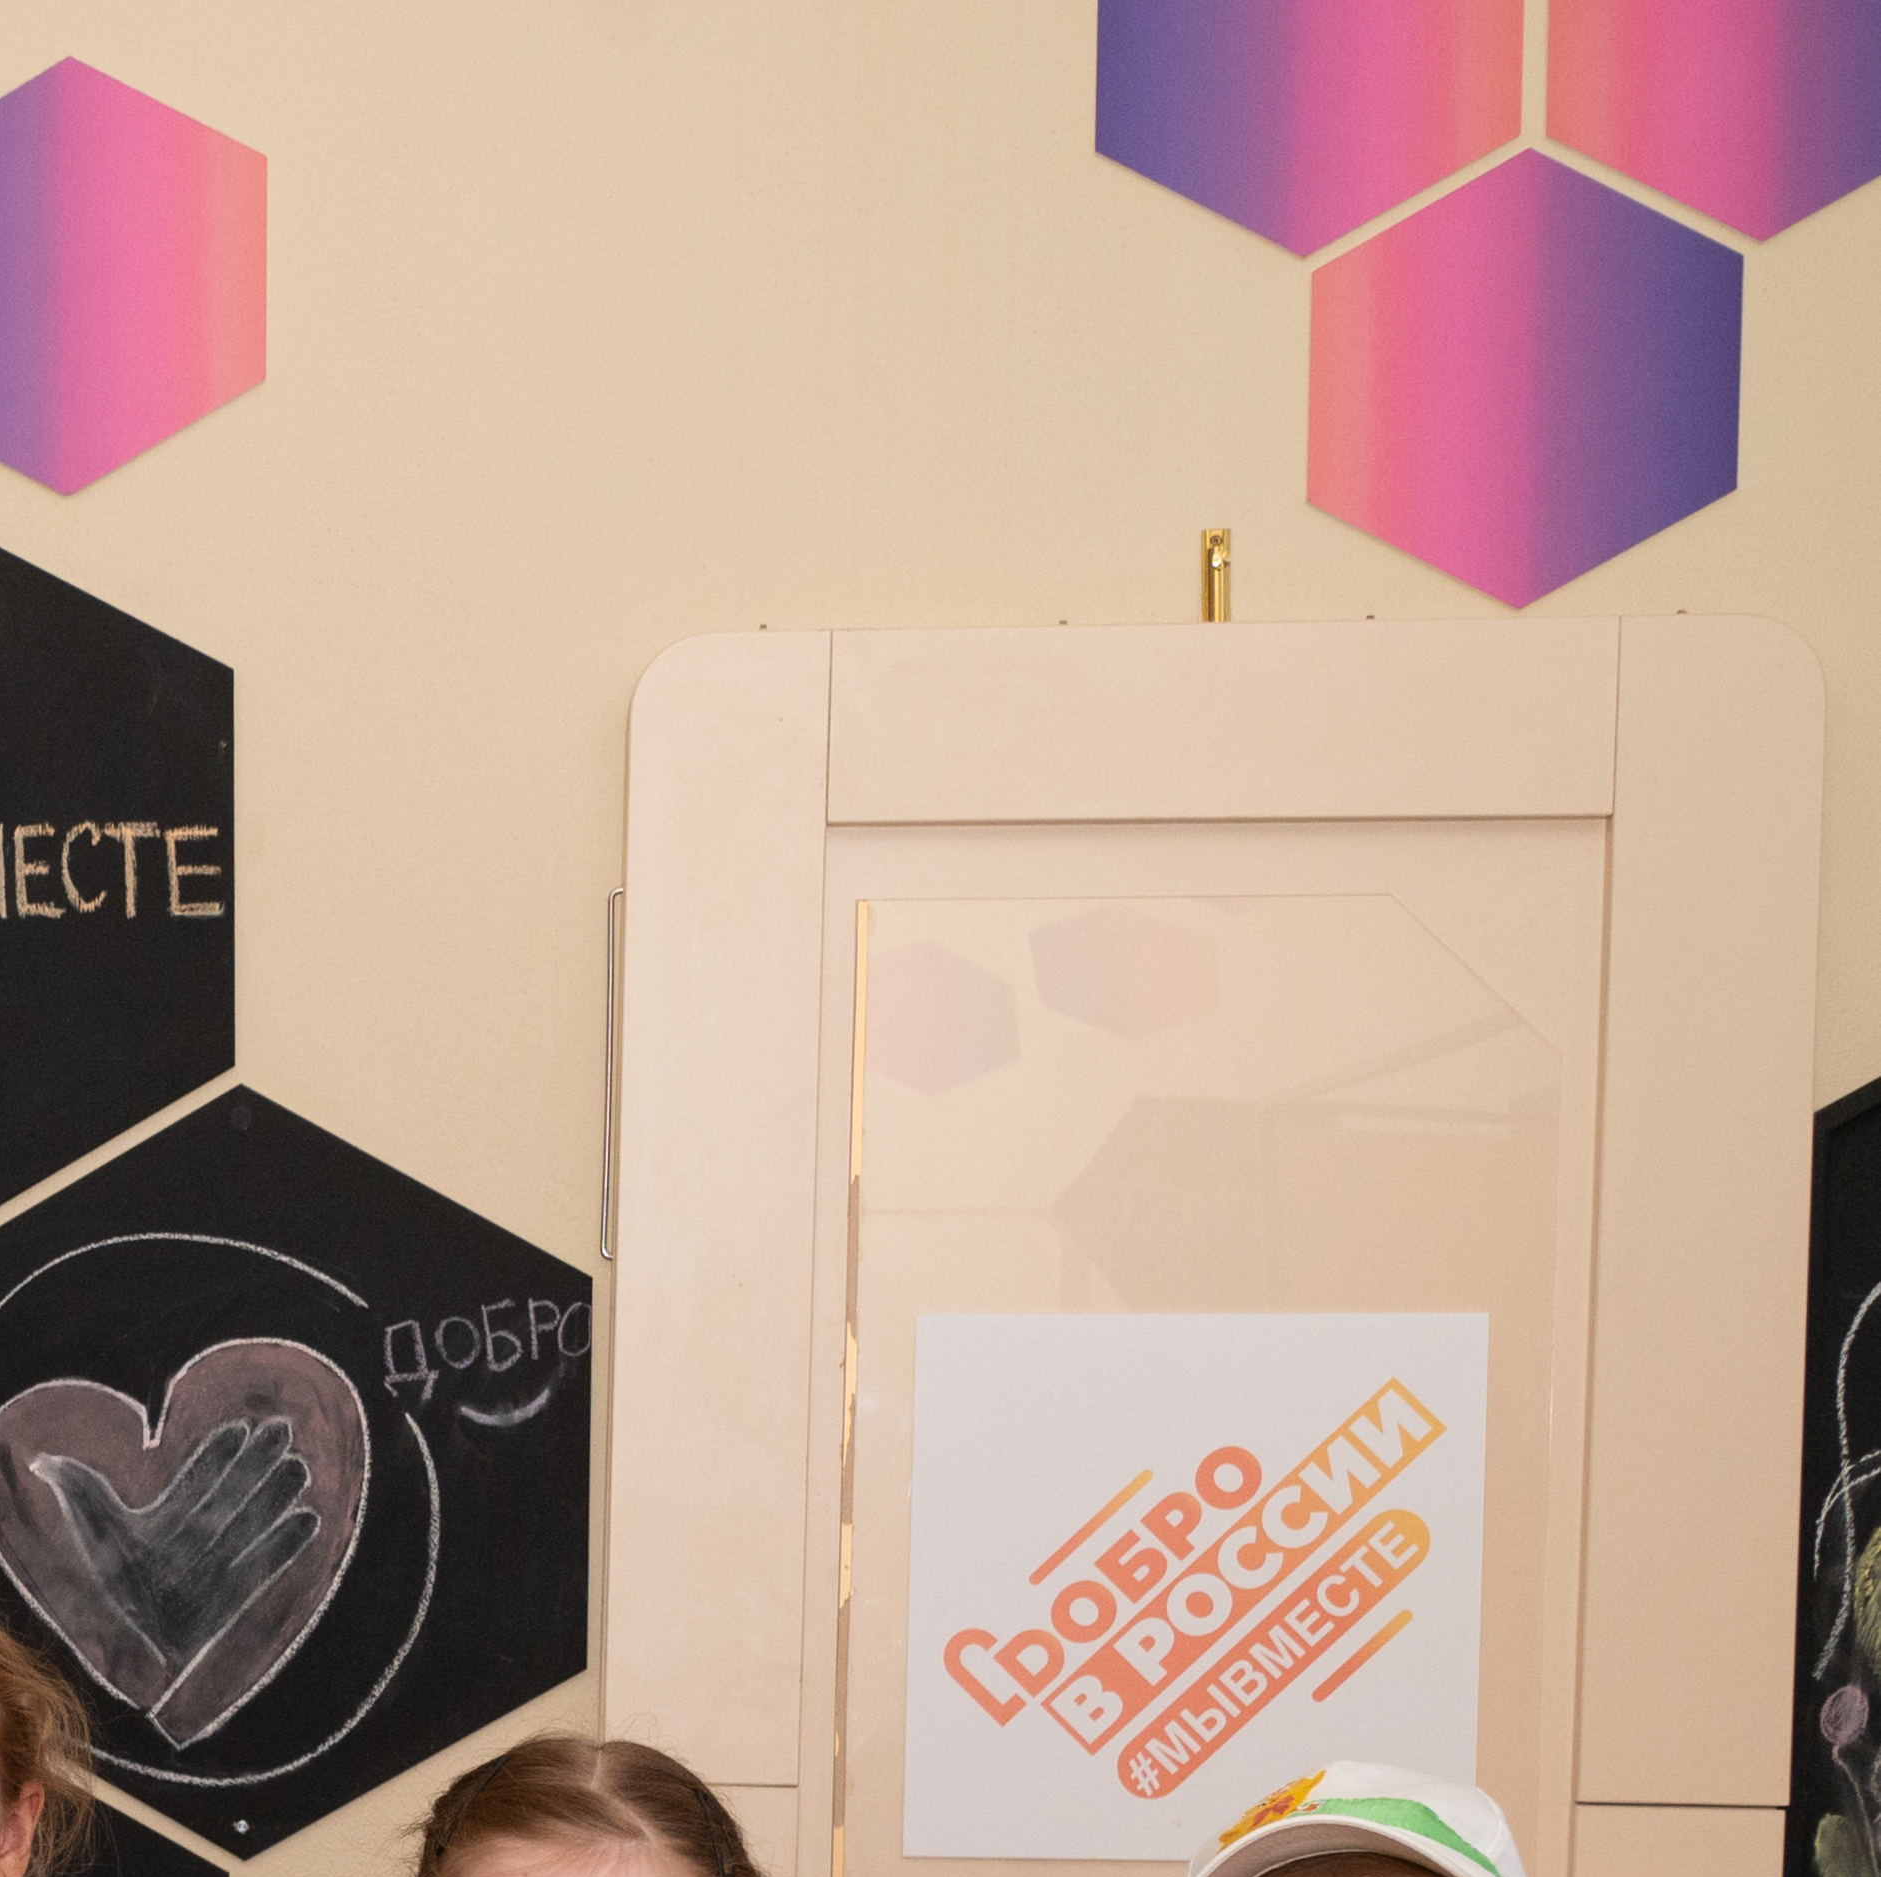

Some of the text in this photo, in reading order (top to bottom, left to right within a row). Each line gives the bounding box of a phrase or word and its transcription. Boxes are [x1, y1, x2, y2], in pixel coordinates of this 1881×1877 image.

[384, 1298, 592, 1400] ДОБРО
[943, 1445, 1262, 1727] ДОБРО
[1049, 1389, 1433, 1744] В РОССИИ
[1128, 1519, 1420, 1798] #МЫВМЕСТЕ
